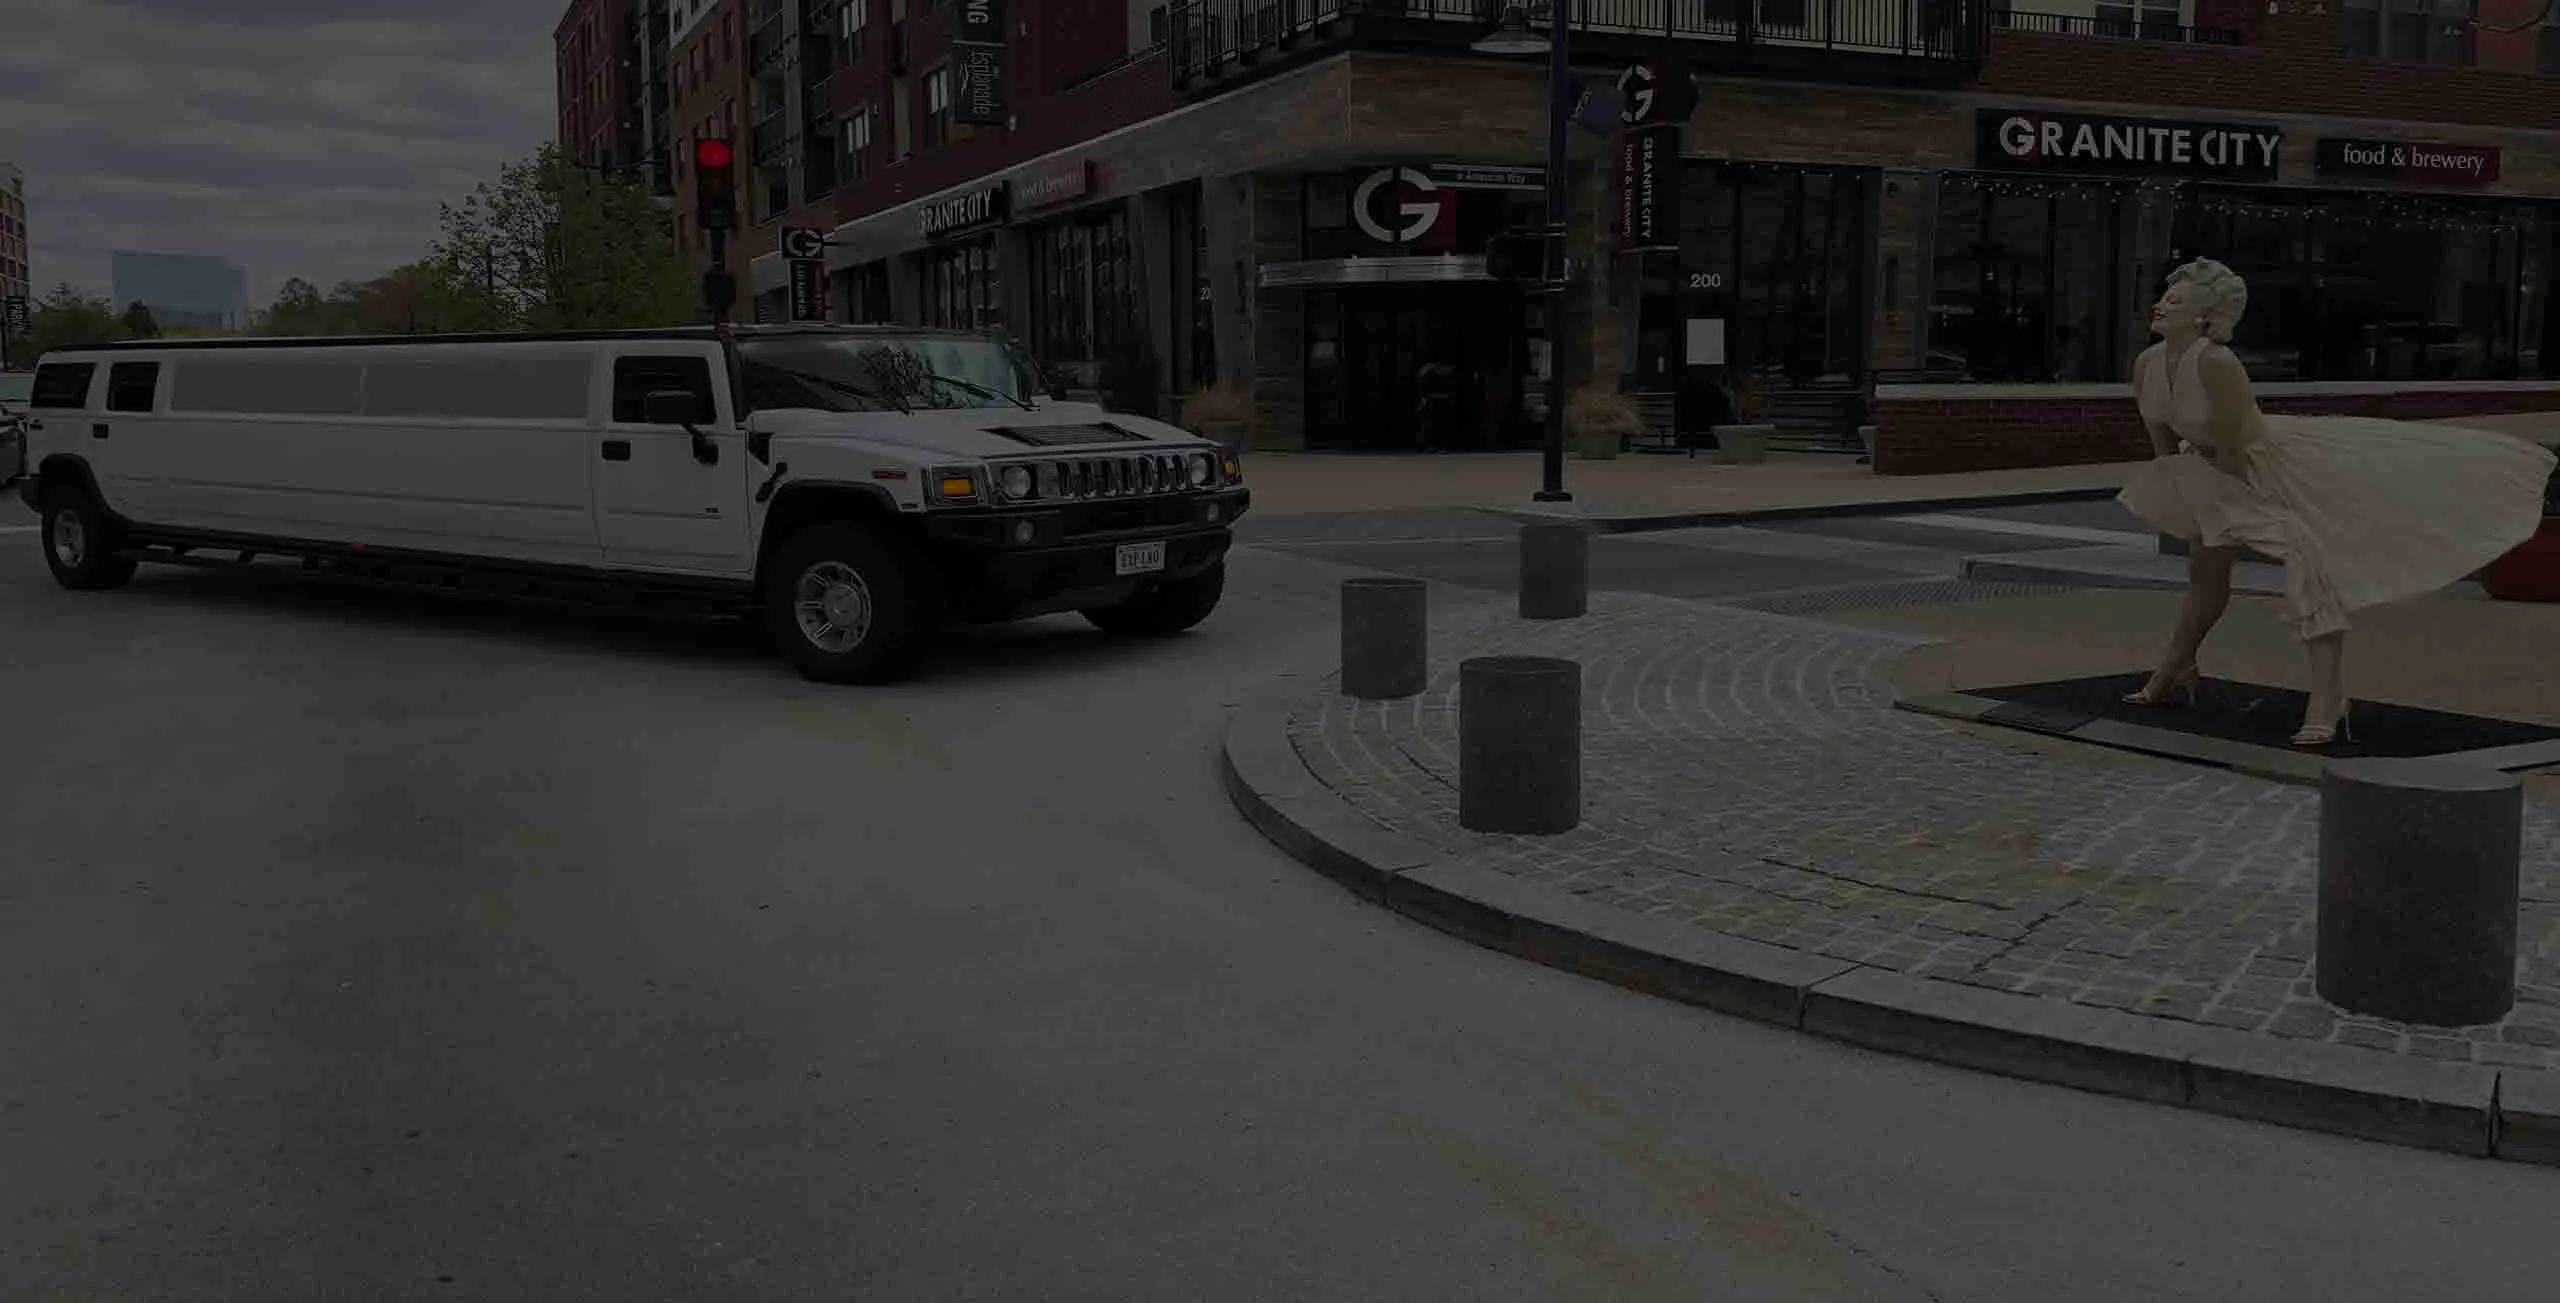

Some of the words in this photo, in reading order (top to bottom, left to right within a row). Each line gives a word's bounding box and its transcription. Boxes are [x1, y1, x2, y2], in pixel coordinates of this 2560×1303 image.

[970, 50, 1000, 115] Esplanade
[1999, 116, 2192, 163] GRANITE
[2200, 128, 2281, 167] CITY
[2343, 143, 2385, 165] food
[2391, 147, 2406, 166] &
[2412, 145, 2485, 178] brewery
[1640, 136, 1654, 207] GRANITE
[918, 196, 967, 235] GRANITE
[967, 188, 992, 224] CITY
[1353, 167, 1441, 243] G
[1639, 208, 1652, 239] CITY
[1689, 272, 1721, 288] 200
